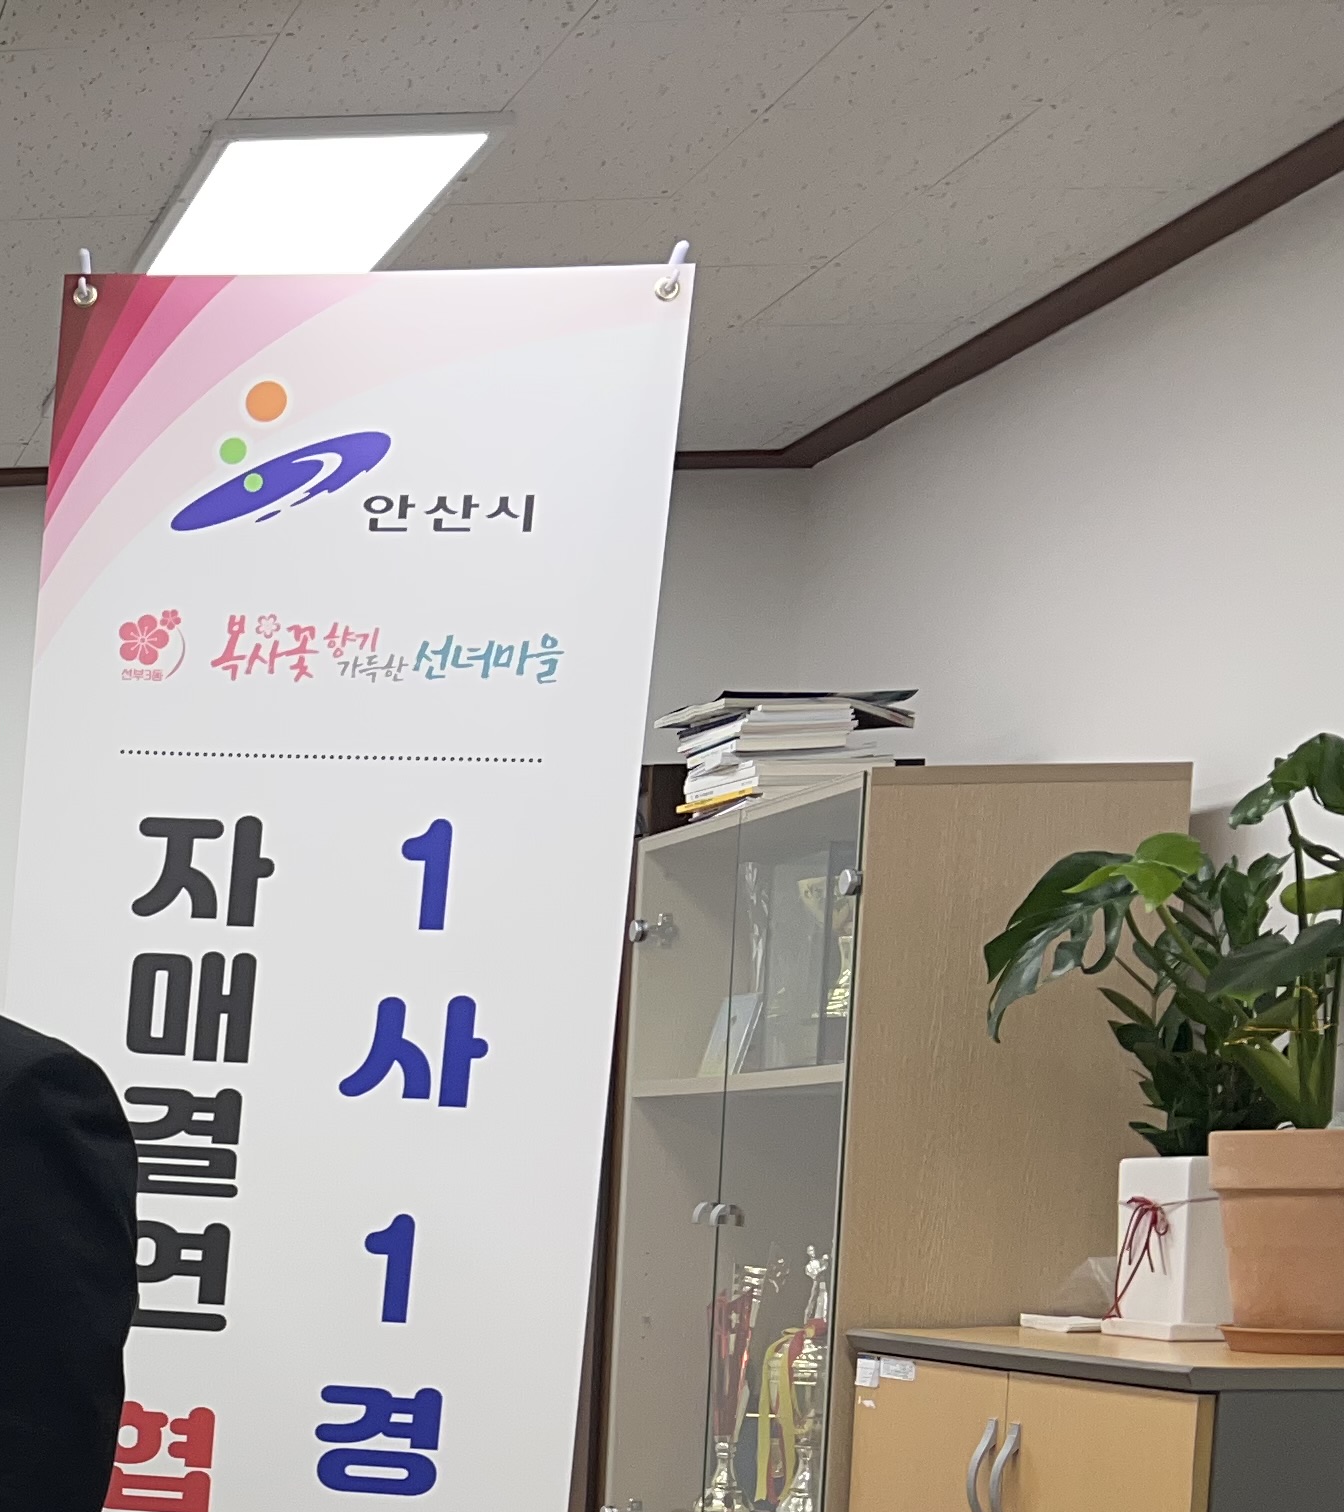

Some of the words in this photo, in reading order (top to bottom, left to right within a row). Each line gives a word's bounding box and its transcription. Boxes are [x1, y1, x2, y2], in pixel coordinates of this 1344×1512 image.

[363, 494, 536, 534] 안산시
[210, 613, 319, 684] 복사꽃
[323, 621, 380, 663] 향기
[412, 633, 566, 685] 선녀마을
[338, 653, 409, 683] 가득한
[124, 815, 276, 1332] 자매결연
